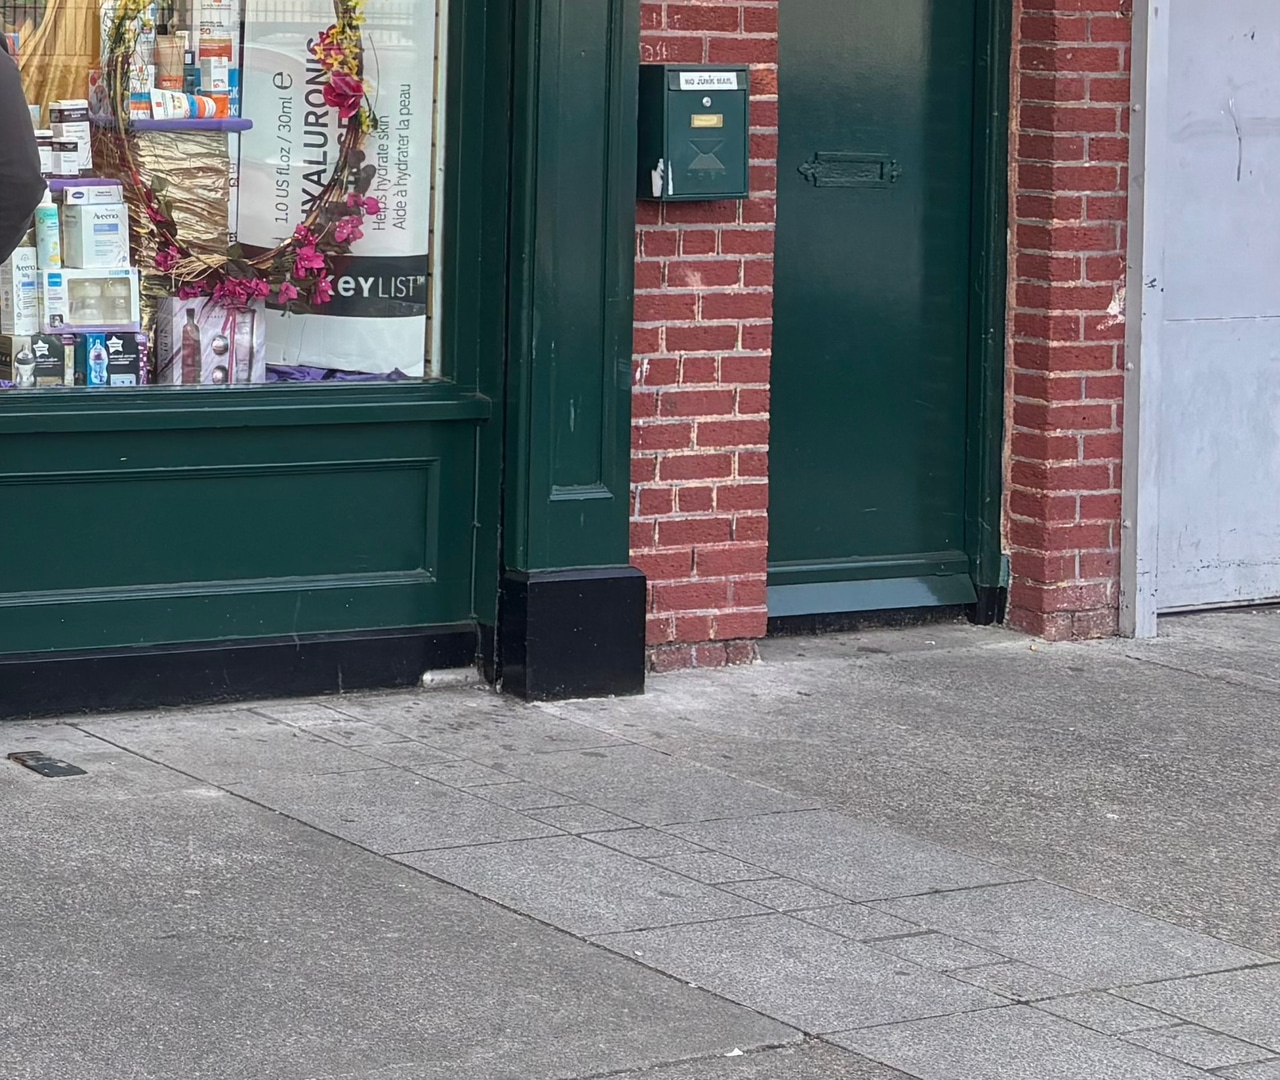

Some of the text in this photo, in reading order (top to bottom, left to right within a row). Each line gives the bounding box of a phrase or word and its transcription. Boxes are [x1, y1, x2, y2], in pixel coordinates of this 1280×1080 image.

[277, 96, 293, 133] 30ml
[376, 115, 390, 141] skin
[276, 147, 291, 176] fl.oz
[374, 143, 391, 192] hydrate
[392, 83, 414, 231] Aide à hydrater la peau
[275, 179, 290, 199] US
[274, 202, 289, 224] 1.0
